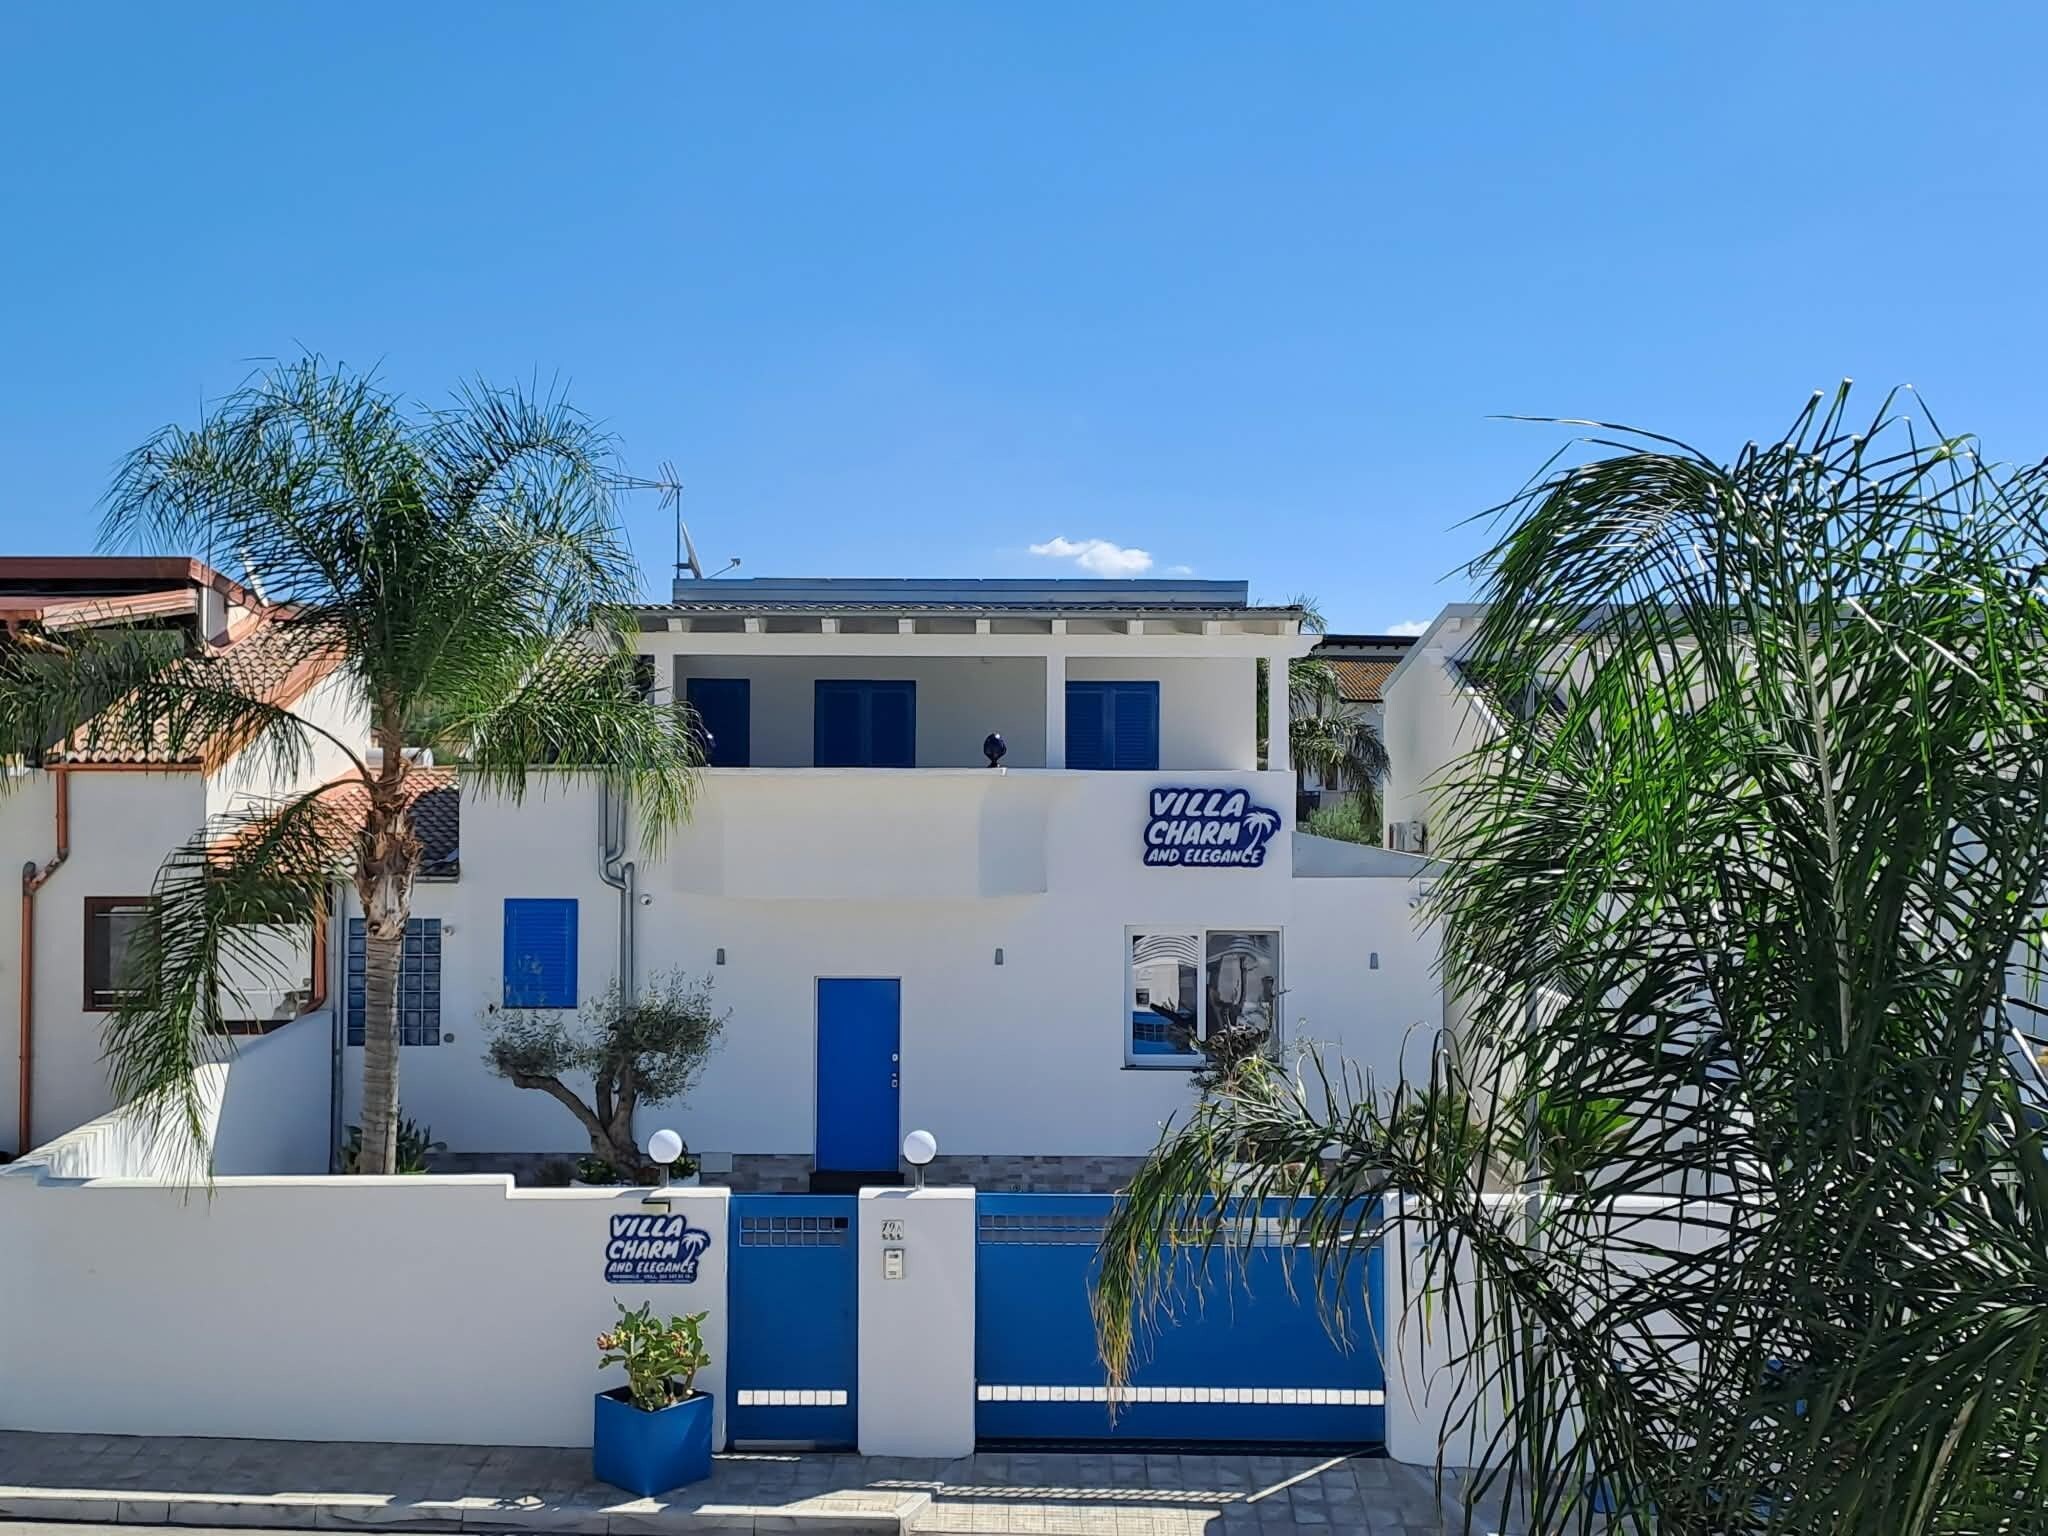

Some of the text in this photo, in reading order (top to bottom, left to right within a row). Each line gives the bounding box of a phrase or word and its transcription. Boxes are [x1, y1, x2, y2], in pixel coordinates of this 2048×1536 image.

[1153, 792, 1246, 817] VILLA
[1148, 820, 1241, 845] CHARM
[1147, 849, 1262, 864] AND ELEGANCE
[613, 1217, 684, 1238] VILLA
[608, 1240, 680, 1259] CHARM
[608, 1261, 694, 1273] AND ELEGANCE
